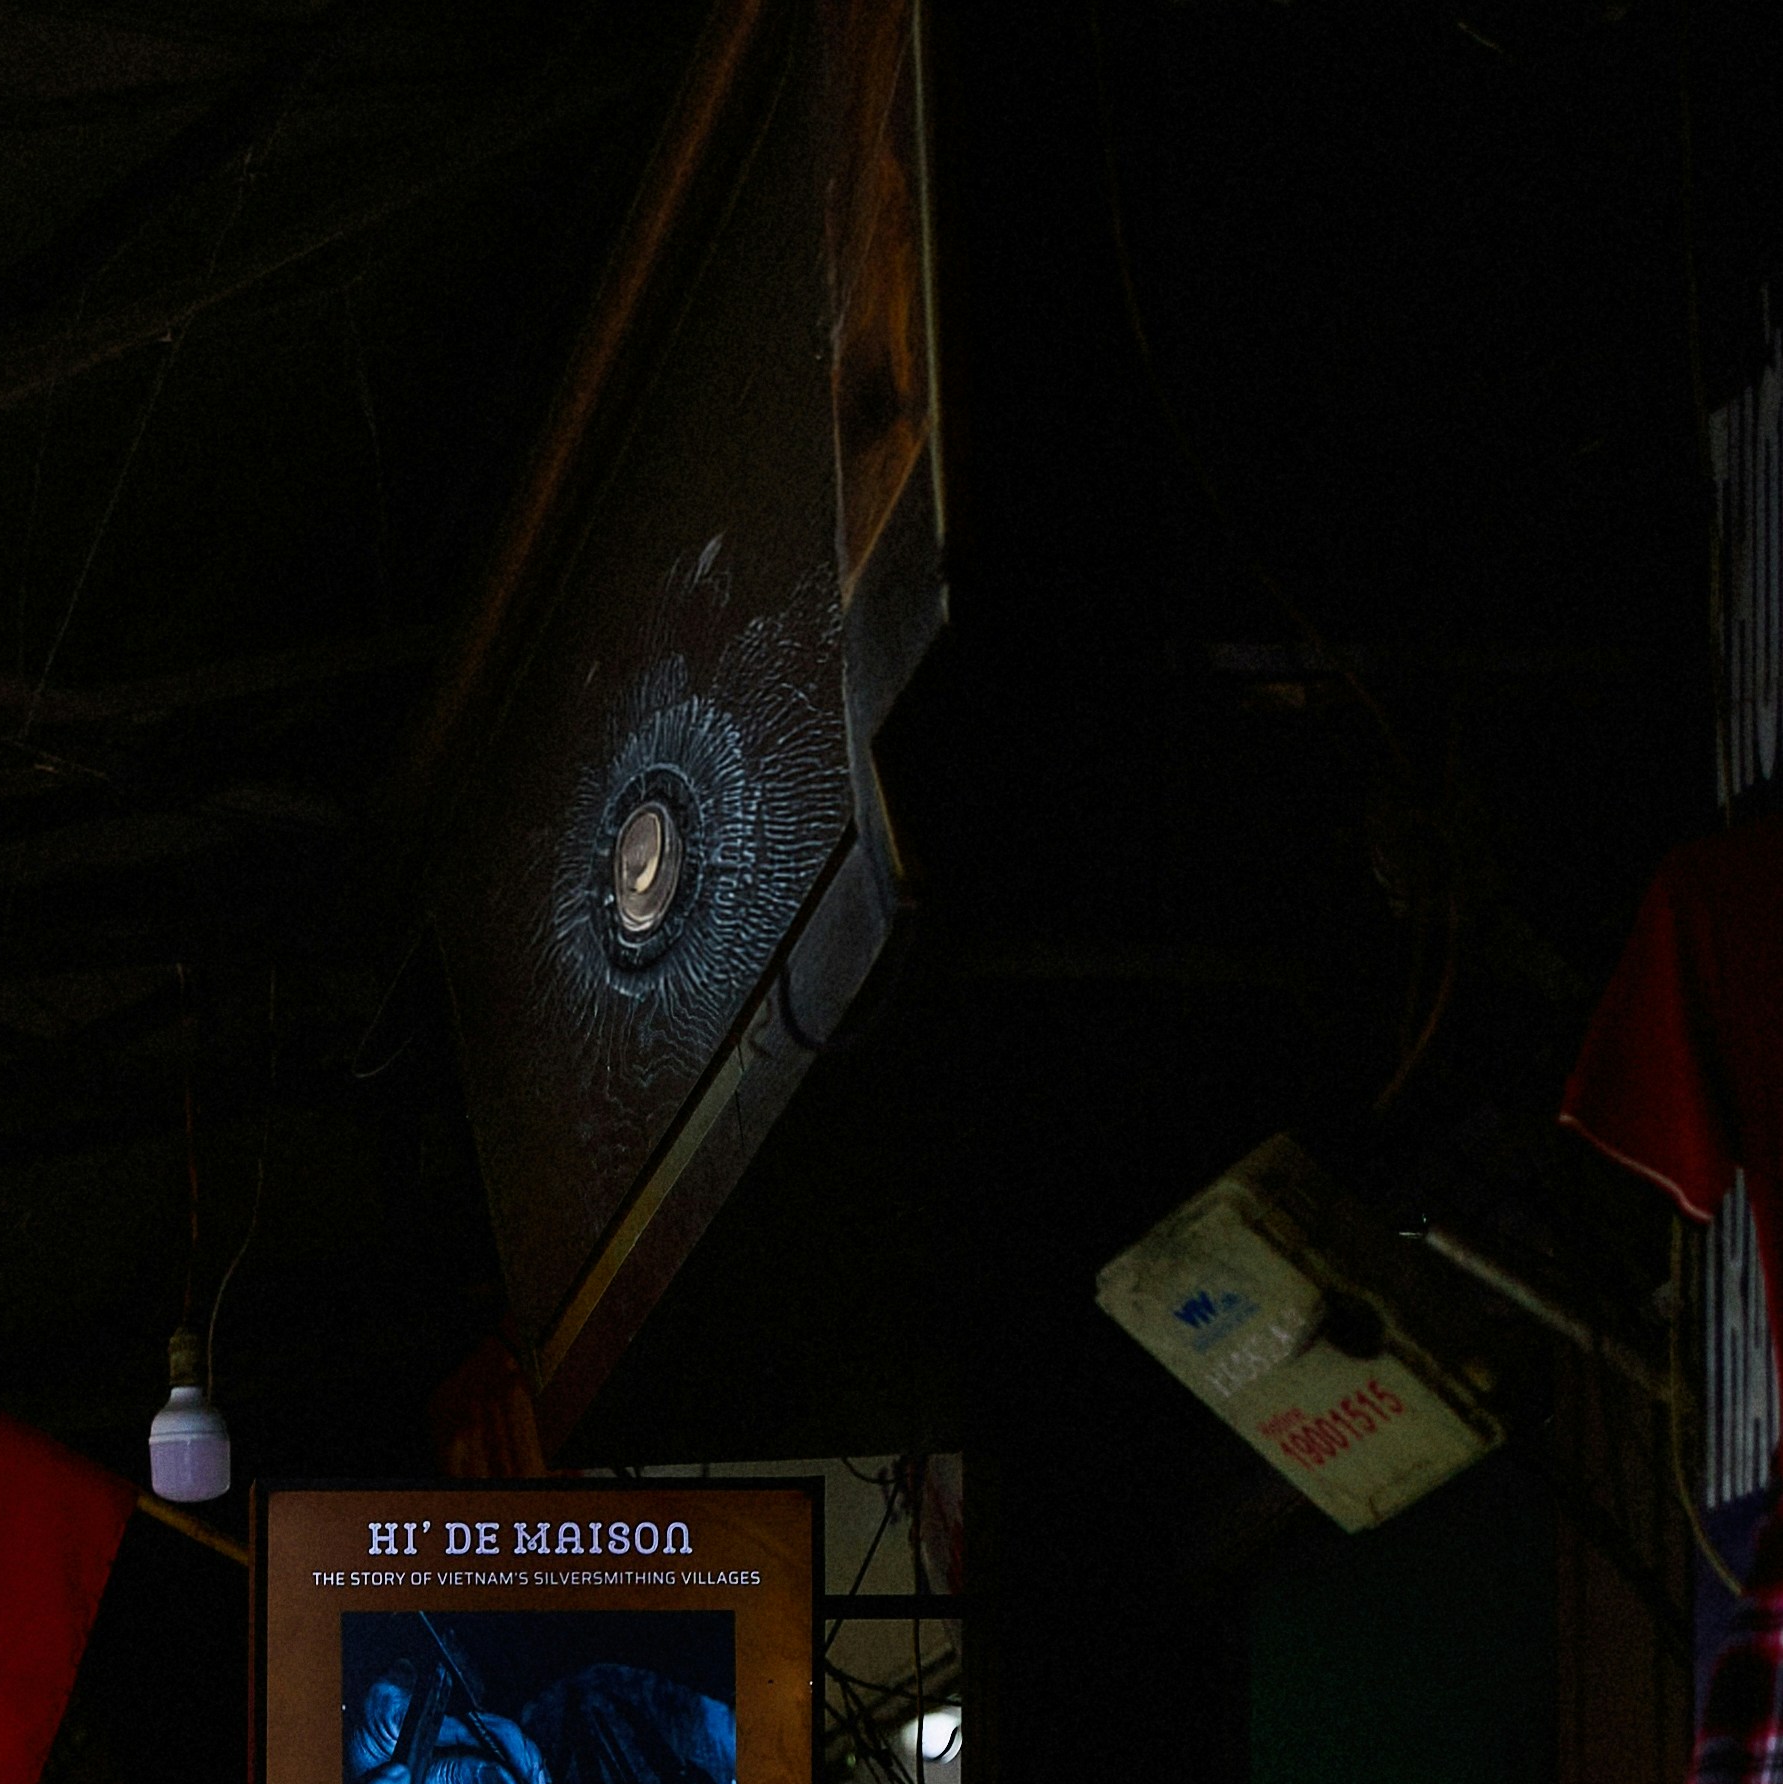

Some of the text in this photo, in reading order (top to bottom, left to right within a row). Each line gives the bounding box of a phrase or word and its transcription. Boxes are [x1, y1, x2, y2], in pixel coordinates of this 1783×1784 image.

[368, 1521, 693, 1555] HI' DE MAISON
[312, 1570, 761, 1587] THE STORY OF VIETNAM'S SILVERSMITHING VILLAGES
